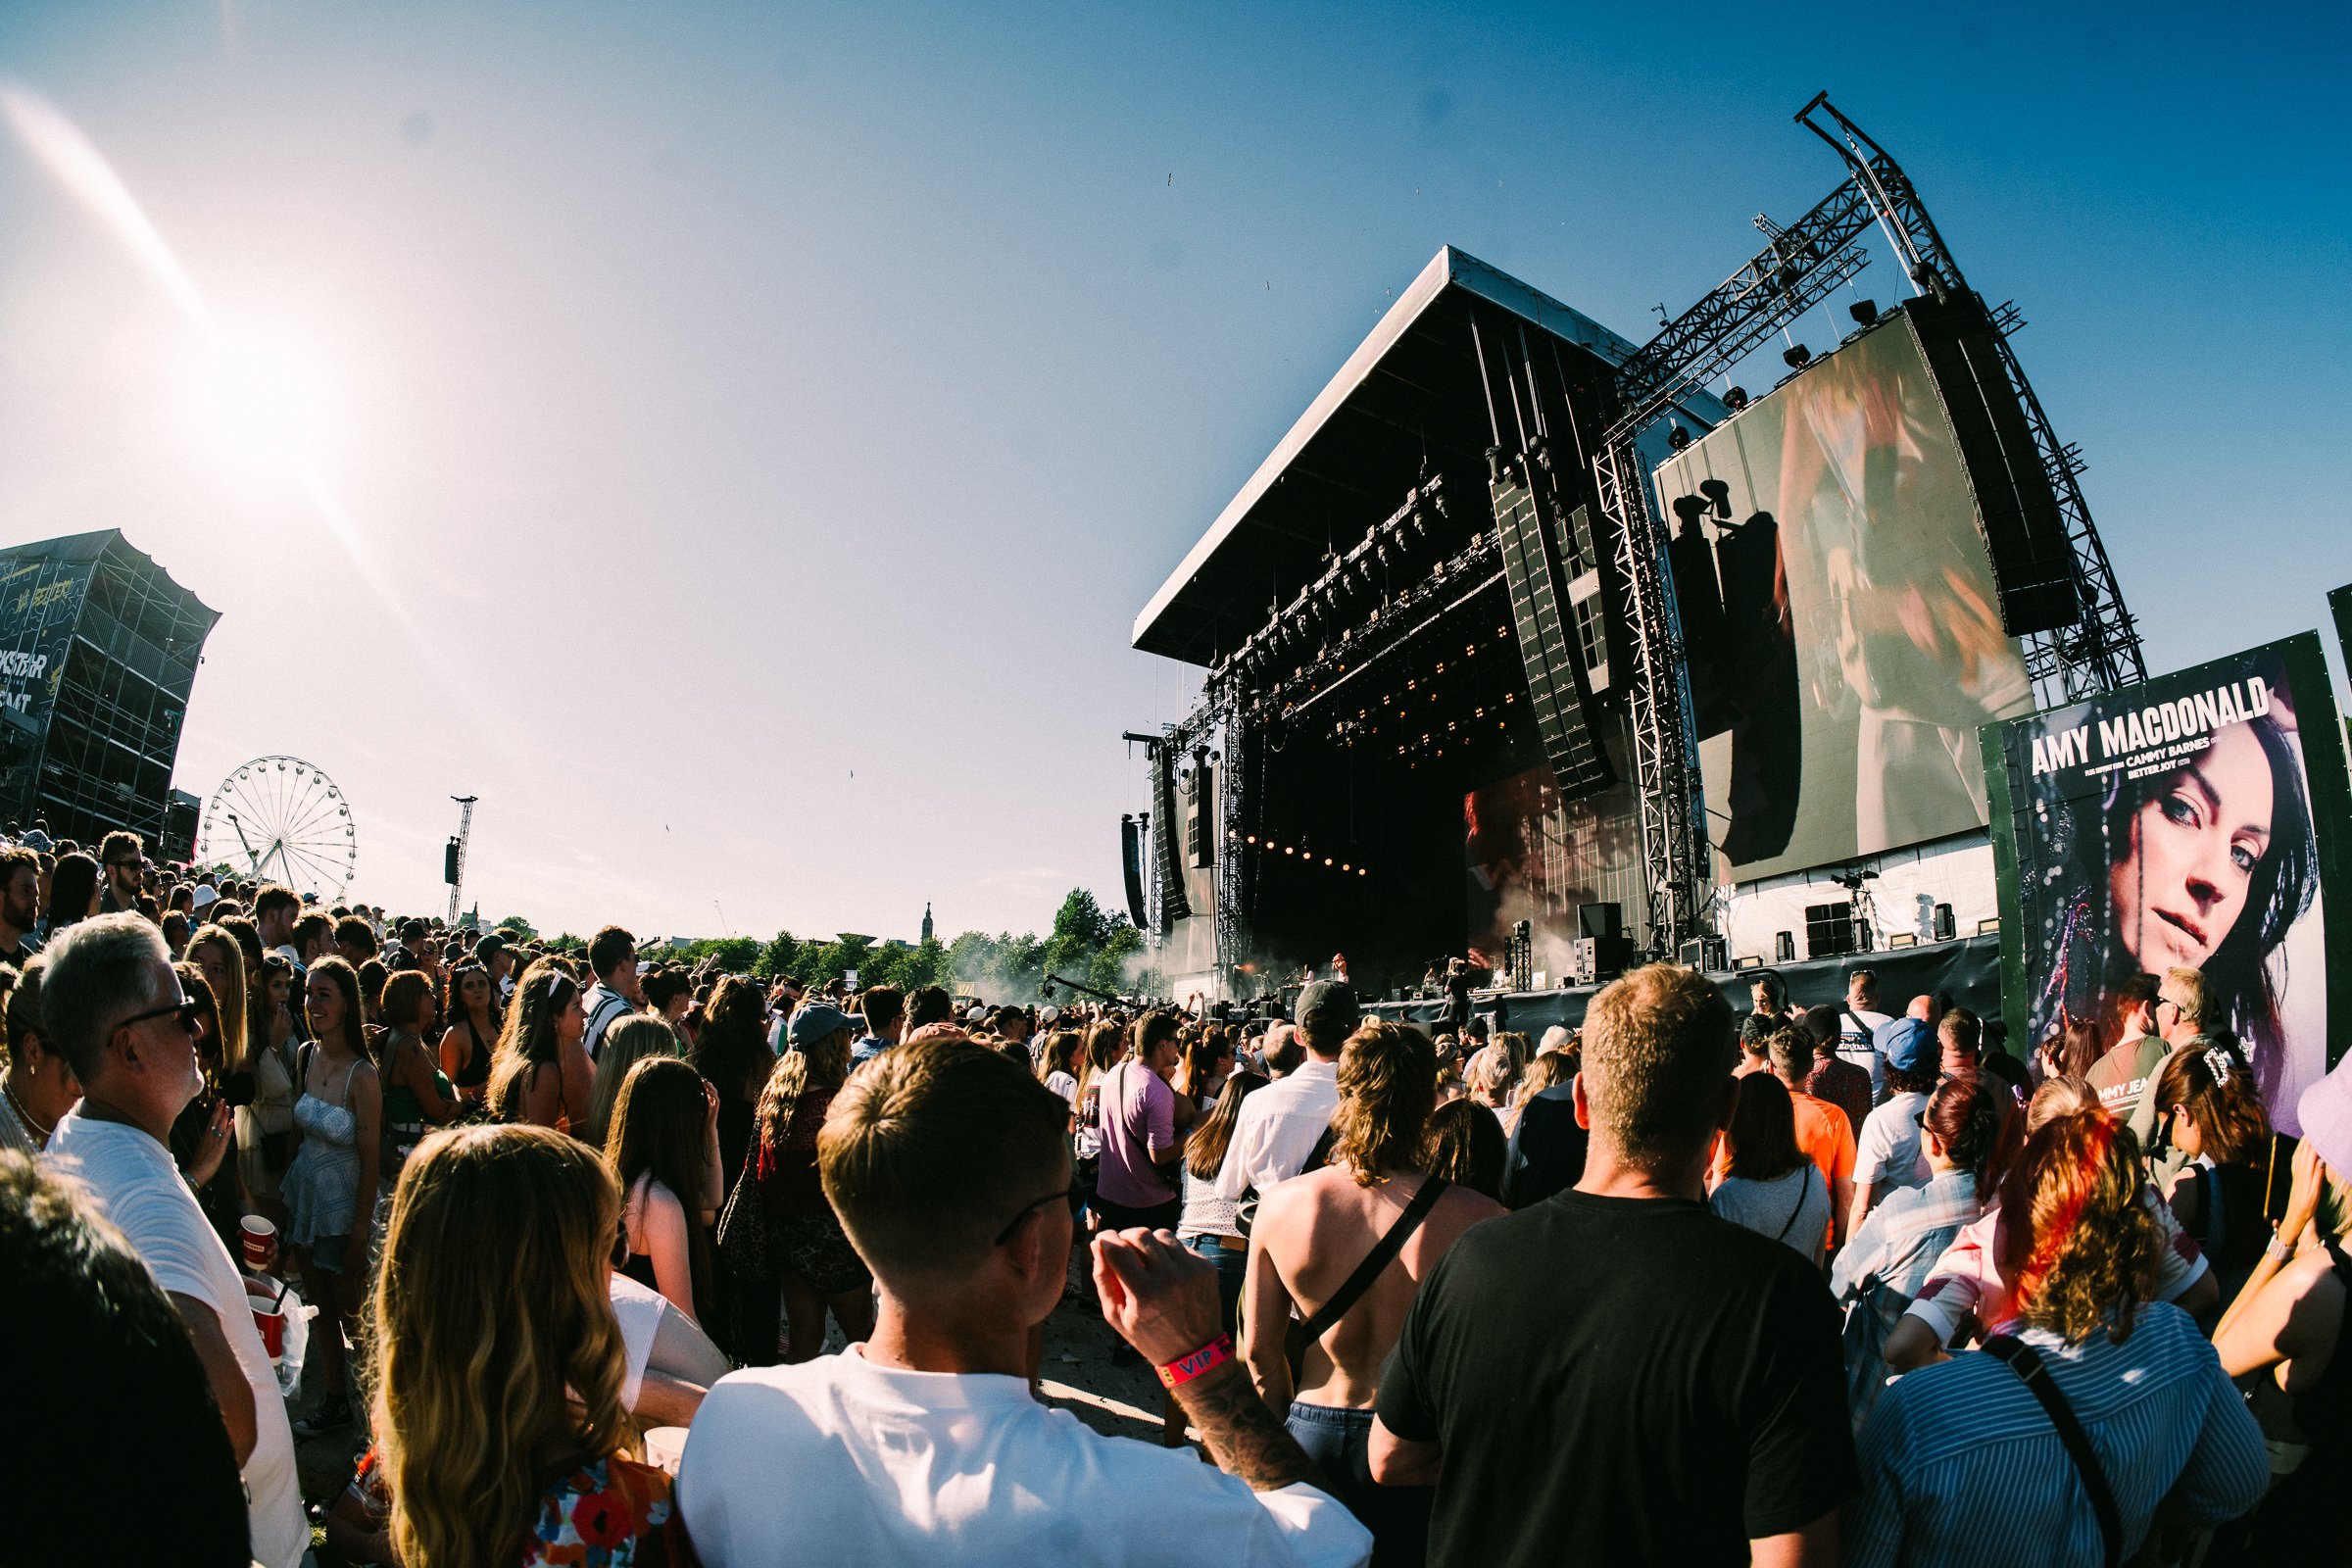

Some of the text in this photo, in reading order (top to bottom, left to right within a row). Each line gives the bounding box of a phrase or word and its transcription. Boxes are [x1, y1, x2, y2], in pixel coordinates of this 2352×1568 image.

[0, 649, 48, 679] KSTAR
[2032, 676, 2270, 776] AMY MACDONALD
[2126, 748, 2166, 767] CAMMY
[2168, 737, 2210, 758] BARNES
[2098, 1083, 2127, 1101] MMY
[2127, 1077, 2148, 1095] JEA
[1178, 1349, 1212, 1375] VIP
